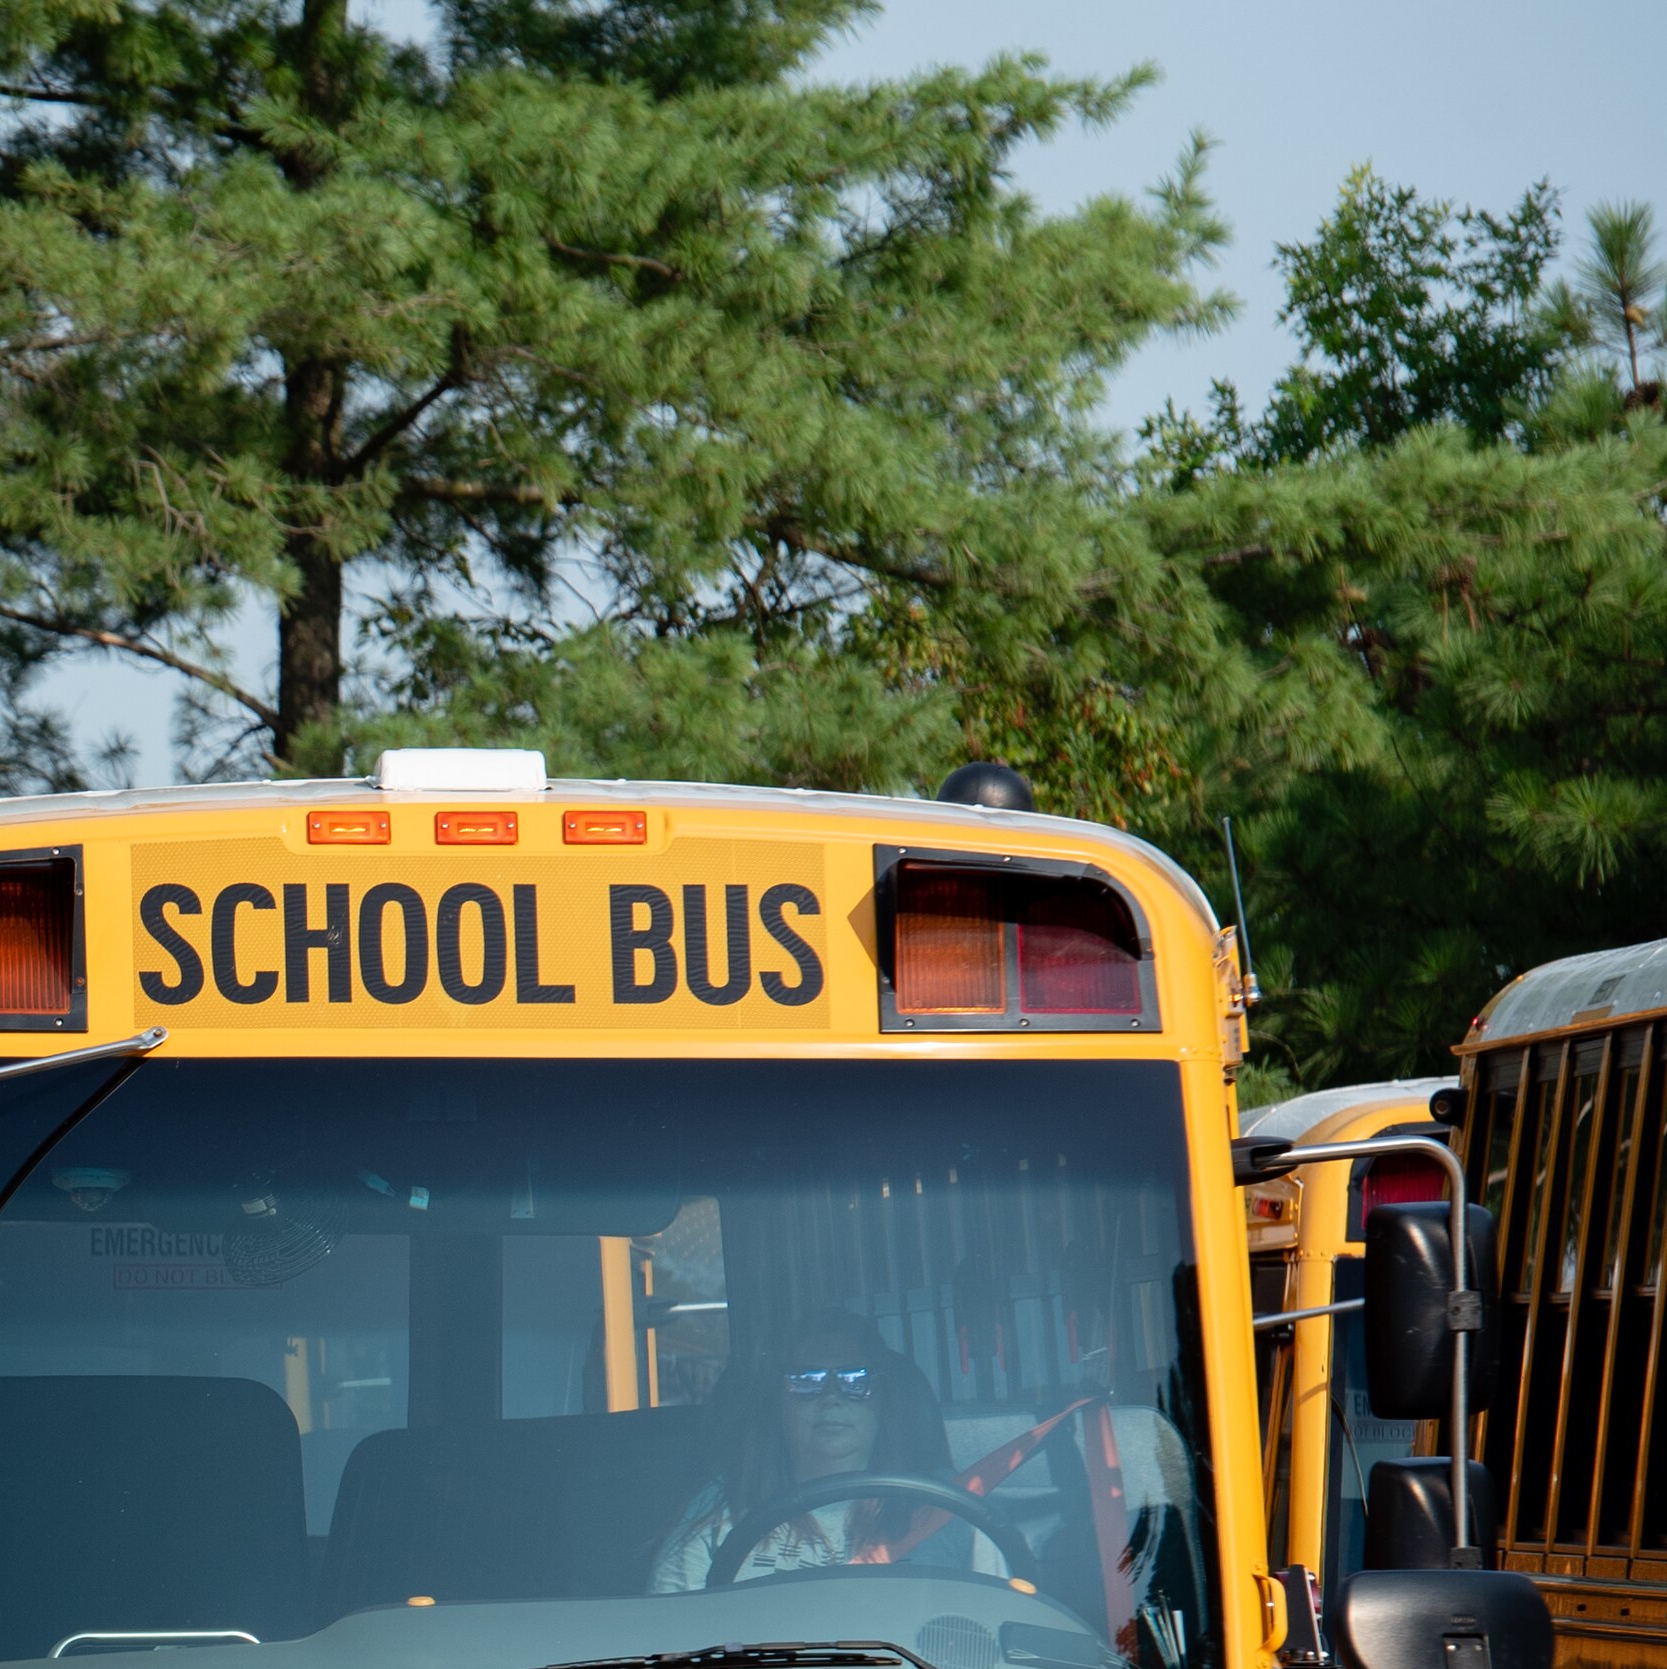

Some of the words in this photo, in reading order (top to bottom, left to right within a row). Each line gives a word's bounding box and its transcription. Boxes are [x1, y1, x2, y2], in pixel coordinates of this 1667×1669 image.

[138, 882, 576, 1006] SCHOOL
[609, 883, 824, 1007] BUS
[91, 1228, 221, 1257] EMERGENC
[117, 1270, 148, 1285] DO
[155, 1270, 195, 1285] NOT
